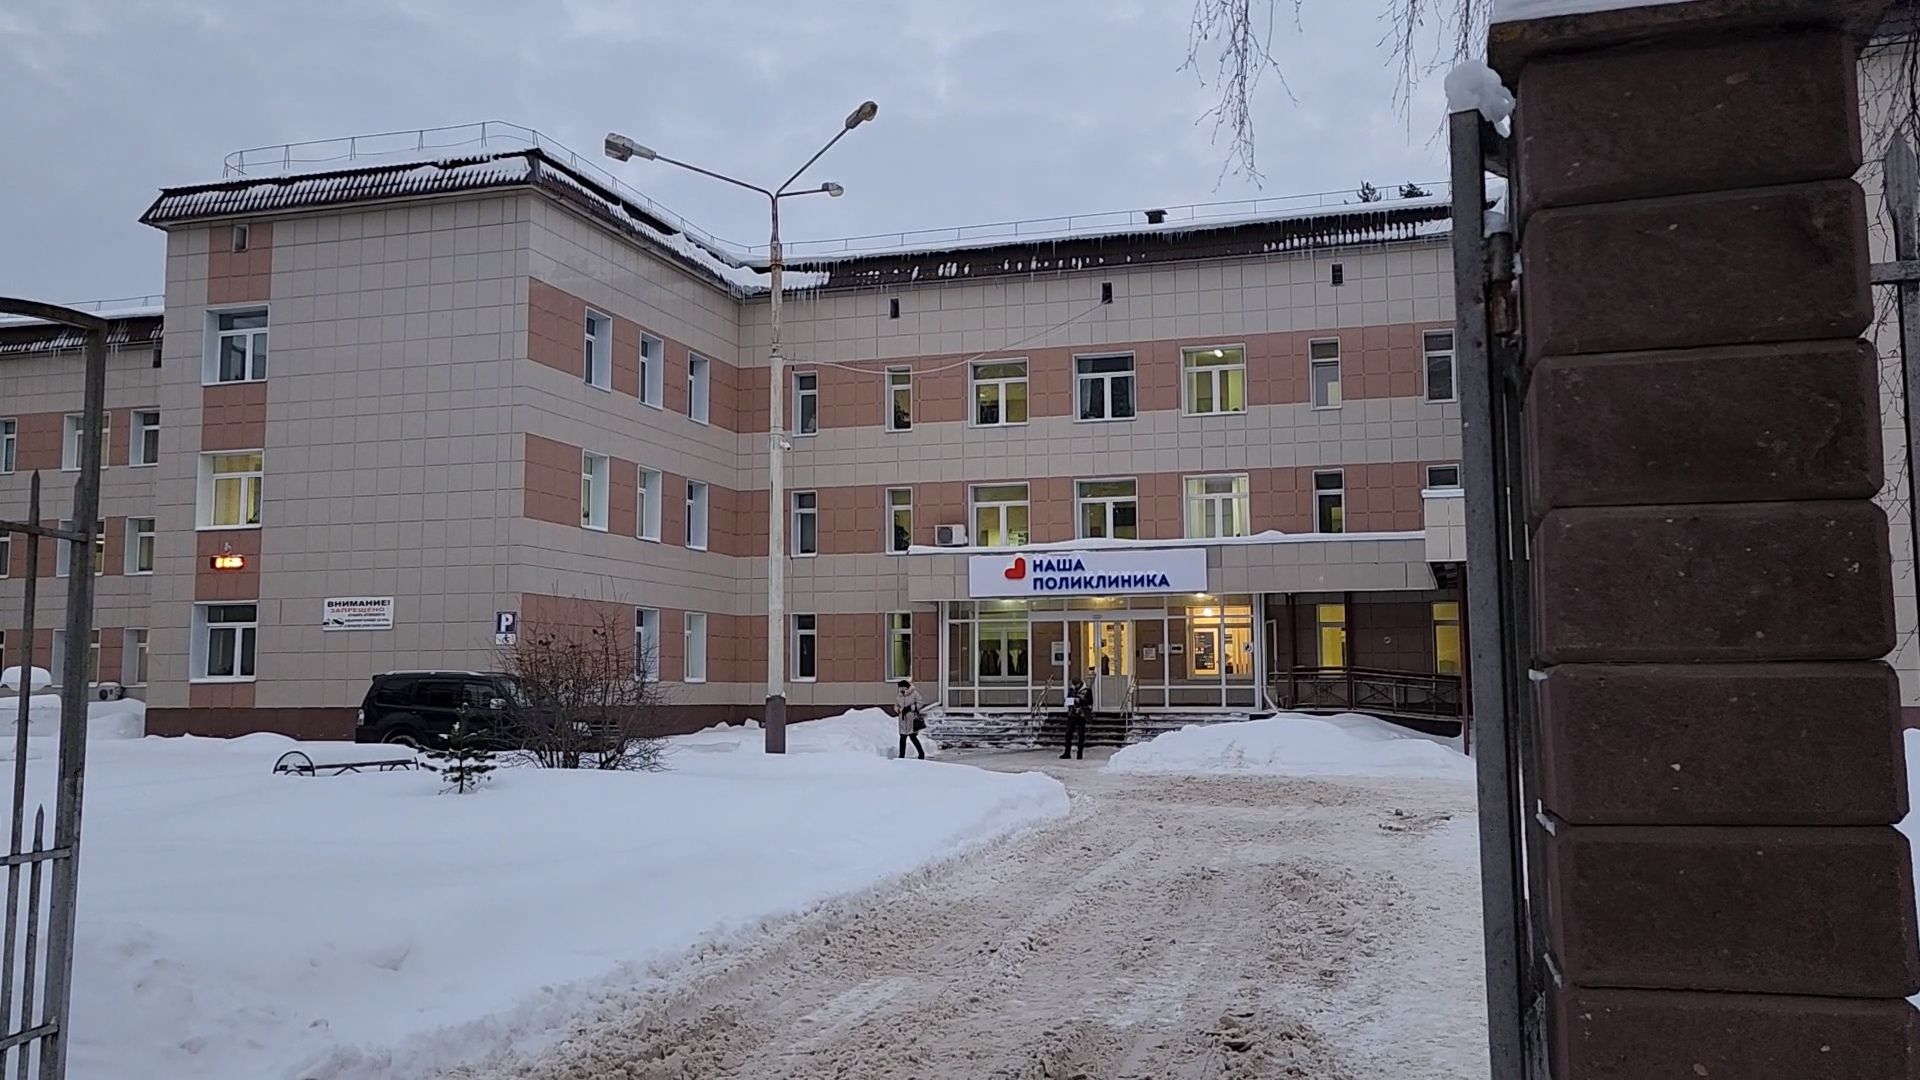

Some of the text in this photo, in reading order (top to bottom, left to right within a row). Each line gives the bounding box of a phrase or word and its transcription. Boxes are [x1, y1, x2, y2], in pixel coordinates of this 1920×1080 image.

[1033, 558, 1085, 572] НАША
[1033, 574, 1170, 590] ПОЛИКЛИНИКА
[500, 613, 513, 632] P
